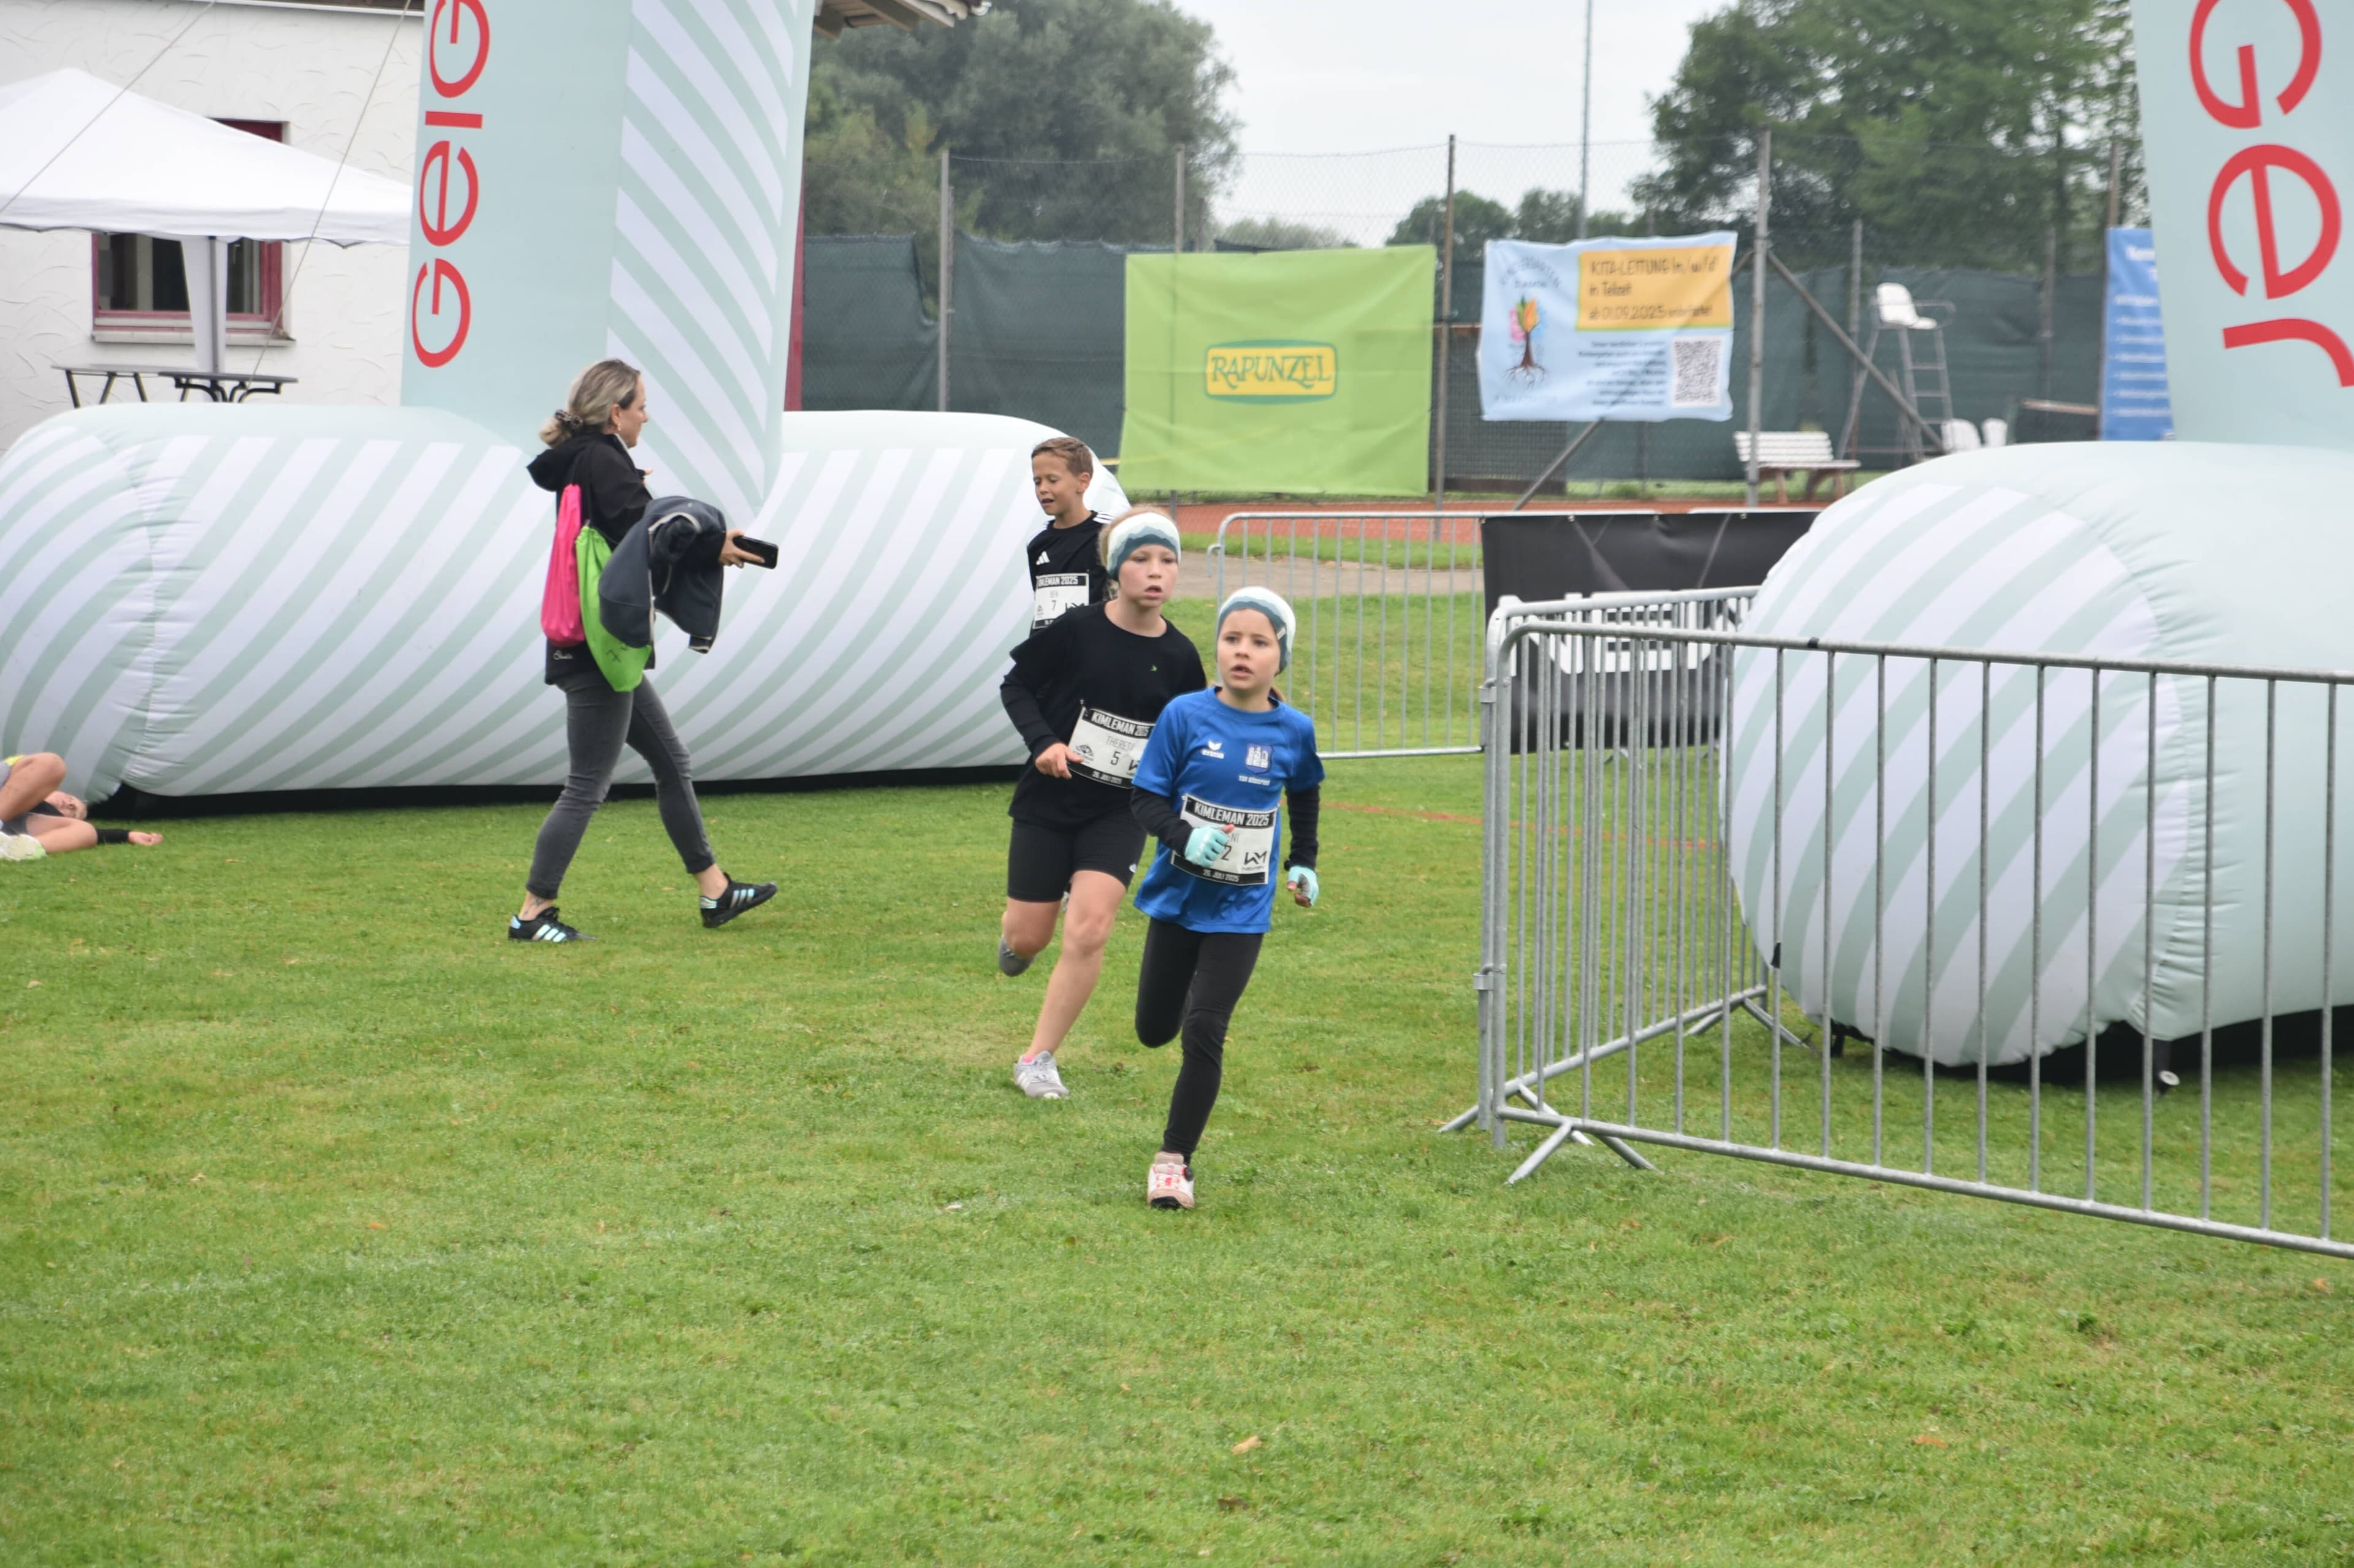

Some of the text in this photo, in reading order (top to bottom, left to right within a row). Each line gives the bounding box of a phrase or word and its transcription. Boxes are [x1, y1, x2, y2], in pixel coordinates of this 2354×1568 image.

[1211, 355, 1332, 389] RAPUNZEL
[1061, 576, 1078, 585] 2025
[1051, 600, 1056, 611] 7
[1091, 712, 1136, 735] KIMLEMAN
[1110, 751, 1121, 765] 5
[1194, 801, 1270, 826] KIMLEMAN 2025
[1221, 844, 1232, 861] 2
